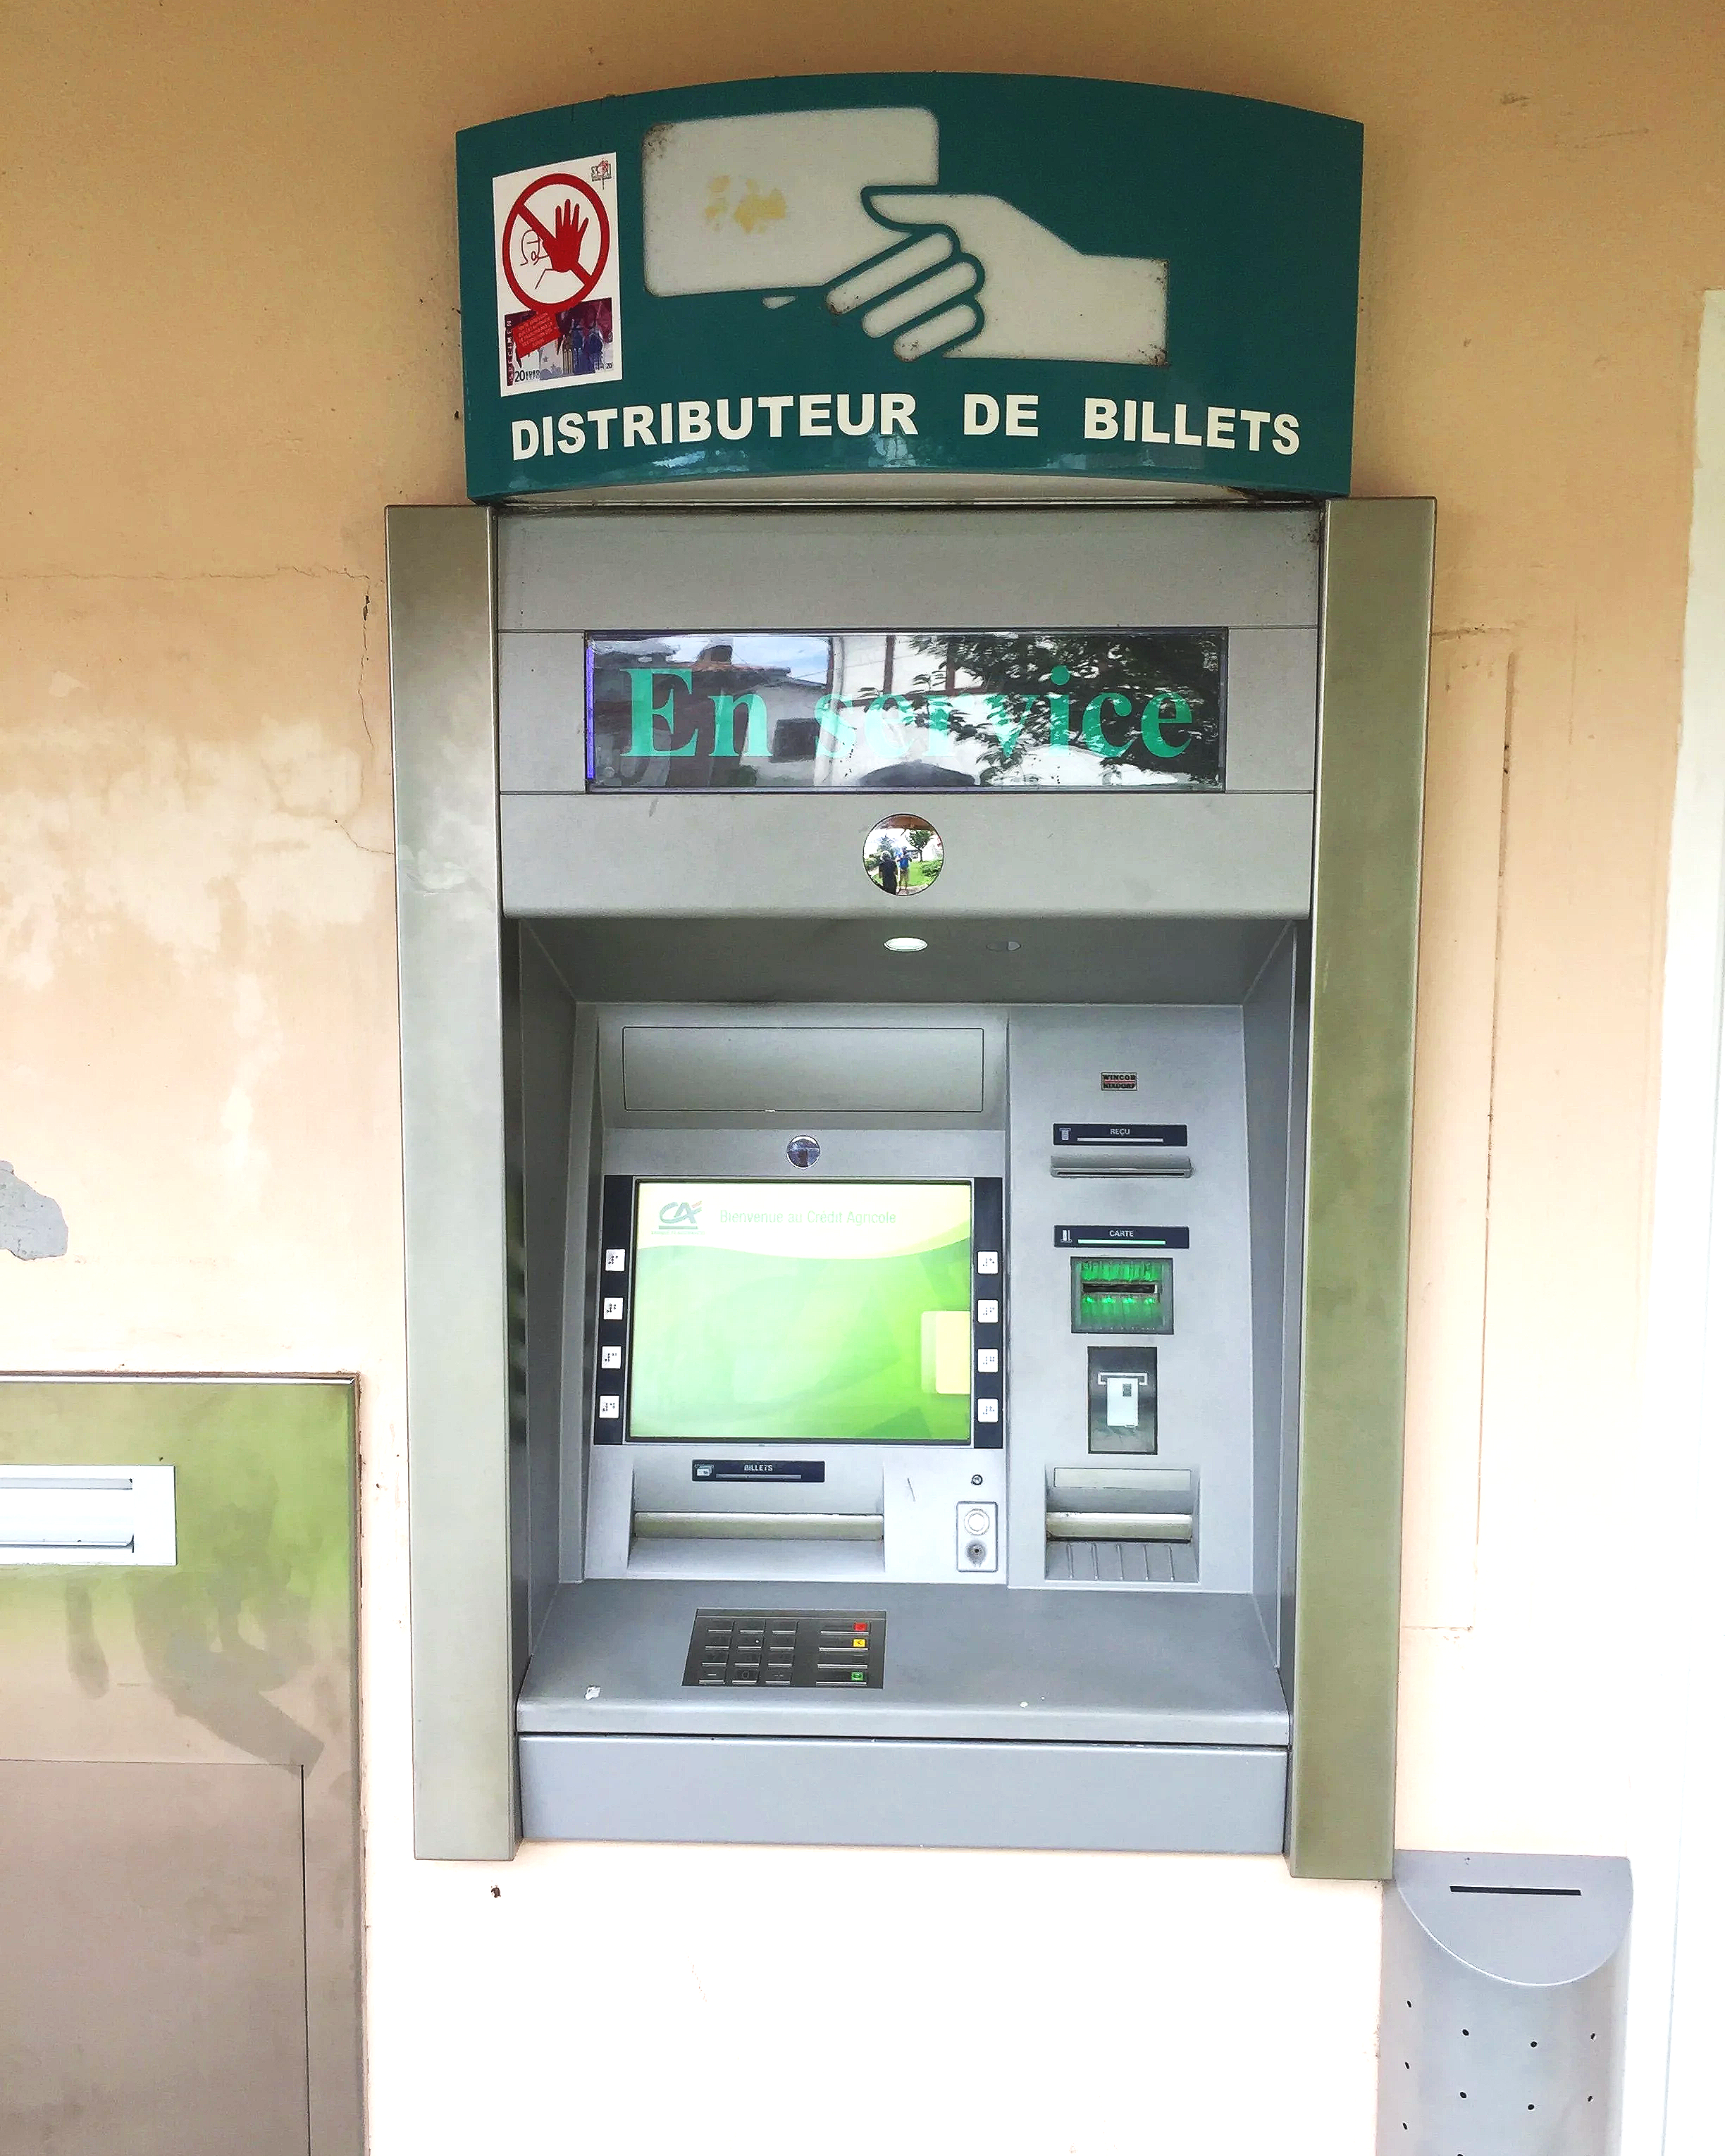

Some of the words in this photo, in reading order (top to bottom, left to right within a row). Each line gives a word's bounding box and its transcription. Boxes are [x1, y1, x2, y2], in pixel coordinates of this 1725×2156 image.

[512, 393, 918, 461] DISTRIBUTEUR
[963, 393, 1039, 437] DE
[1084, 397, 1301, 455] BILLETS
[619, 667, 772, 757] En
[815, 666, 1194, 759] service
[719, 1210, 784, 1224] Bienvenue
[788, 1213, 803, 1224] au
[808, 1210, 843, 1224] Crédit
[846, 1210, 896, 1227] Agricole
